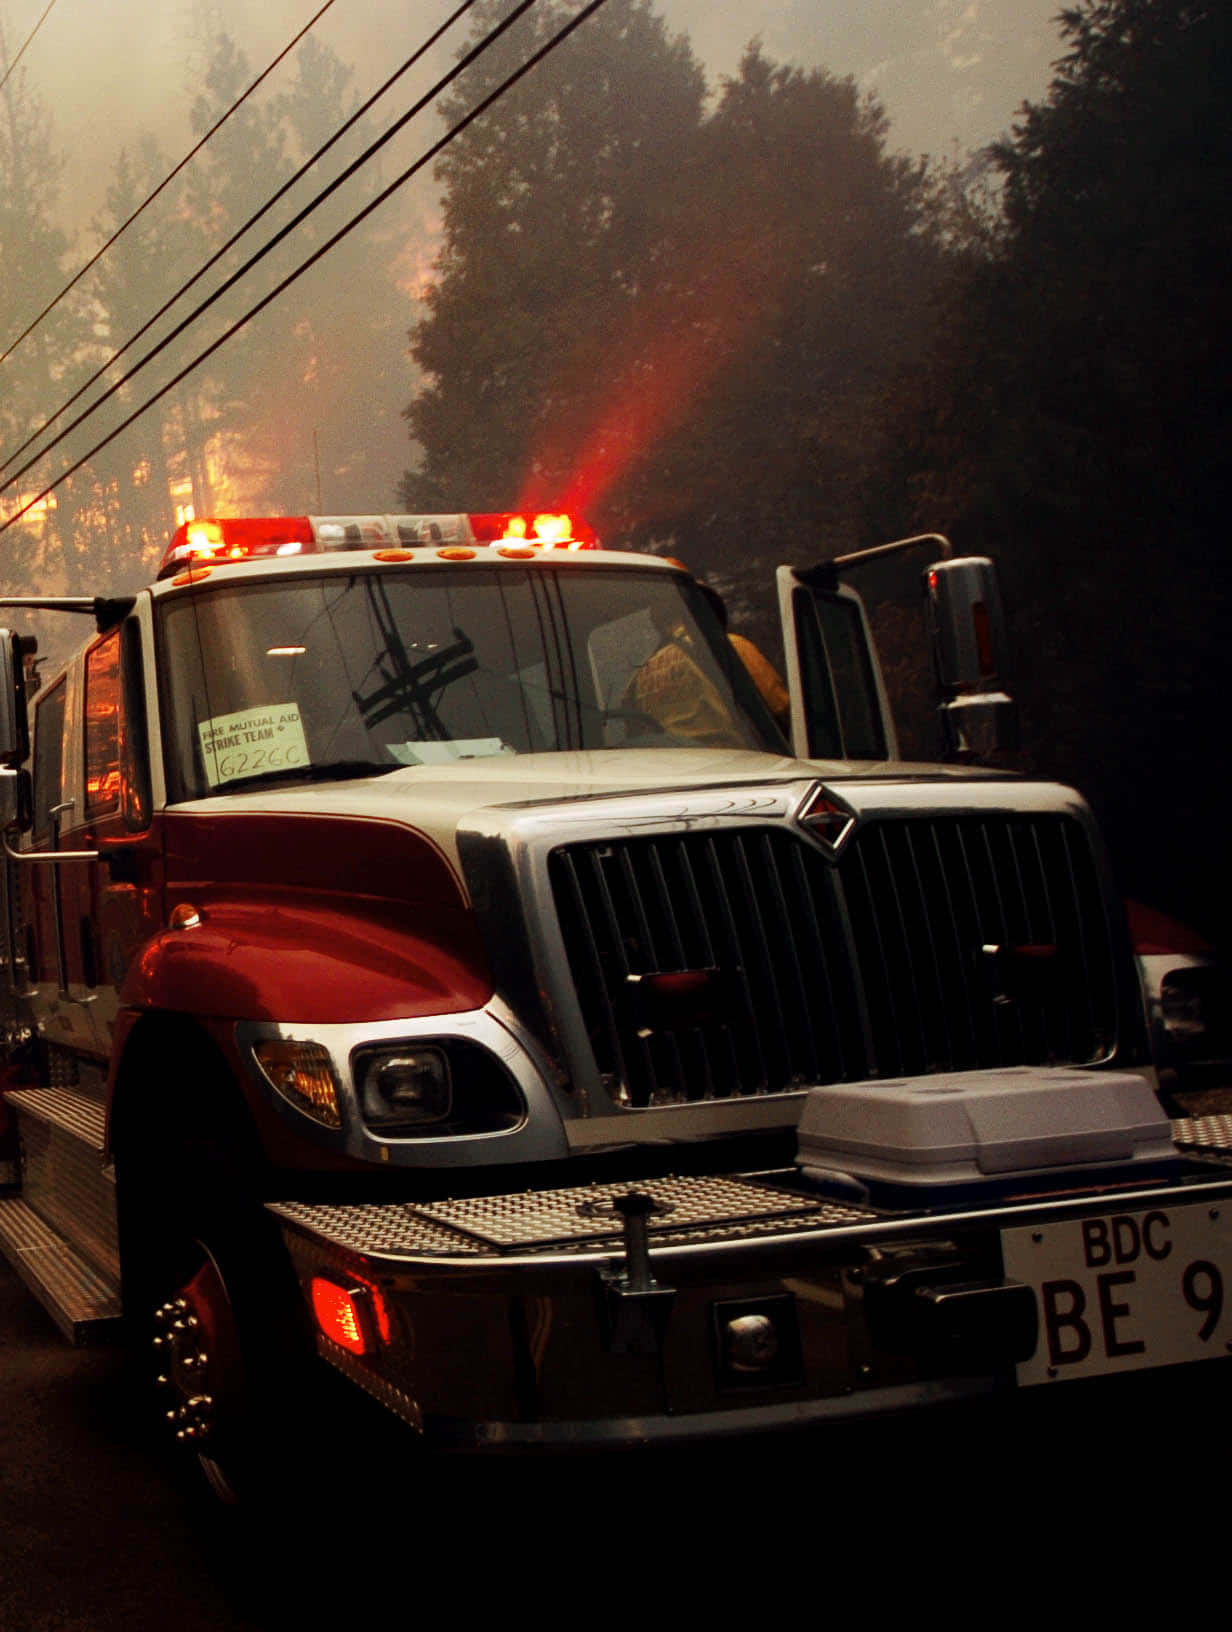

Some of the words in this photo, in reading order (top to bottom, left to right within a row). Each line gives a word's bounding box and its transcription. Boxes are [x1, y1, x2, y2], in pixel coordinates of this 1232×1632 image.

[202, 726, 224, 740] FIRE
[229, 717, 274, 732] MUTUAL
[279, 713, 299, 723] AID
[205, 734, 241, 754] STRIKE
[243, 728, 274, 743] TEAM
[1082, 1210, 1173, 1268] BDC
[1042, 1270, 1146, 1367] BE
[1181, 1260, 1224, 1342] 9
